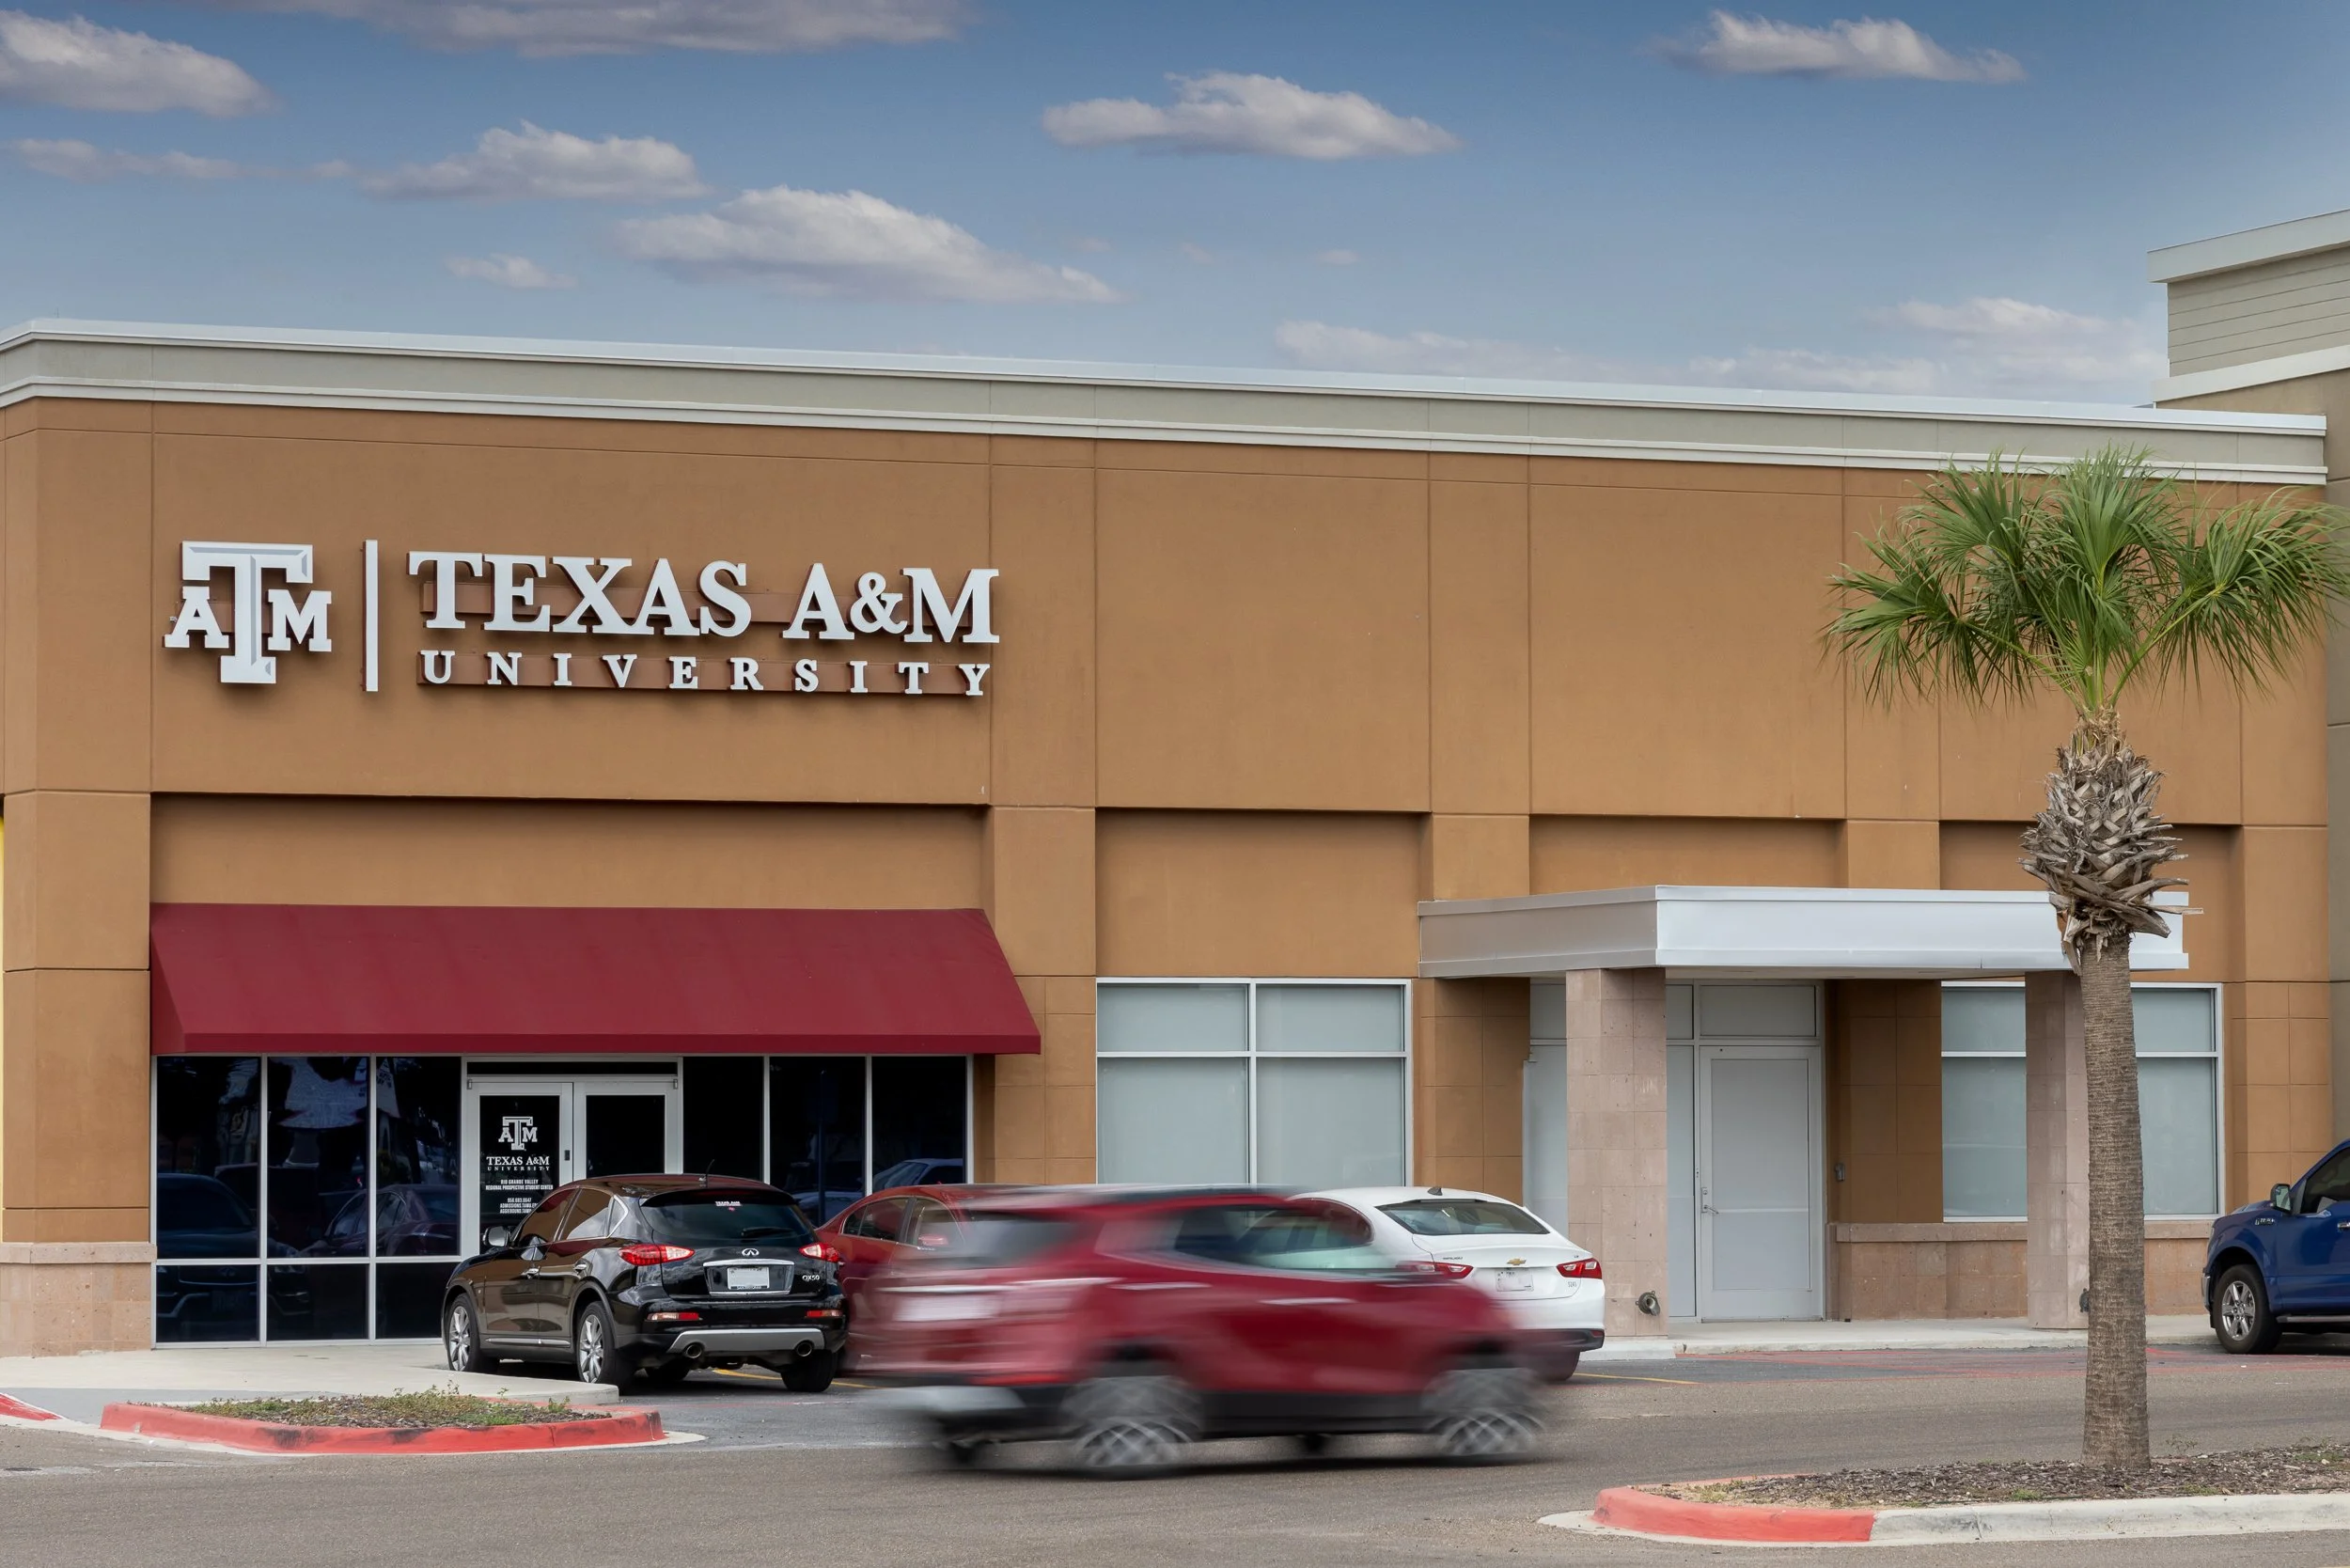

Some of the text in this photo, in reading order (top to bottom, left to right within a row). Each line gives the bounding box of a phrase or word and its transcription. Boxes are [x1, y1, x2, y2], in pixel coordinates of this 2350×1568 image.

[408, 551, 1000, 645] TEXAS A&M
[420, 649, 992, 698] UNIVERSITY
[486, 1156, 550, 1166] TEXAS A&M
